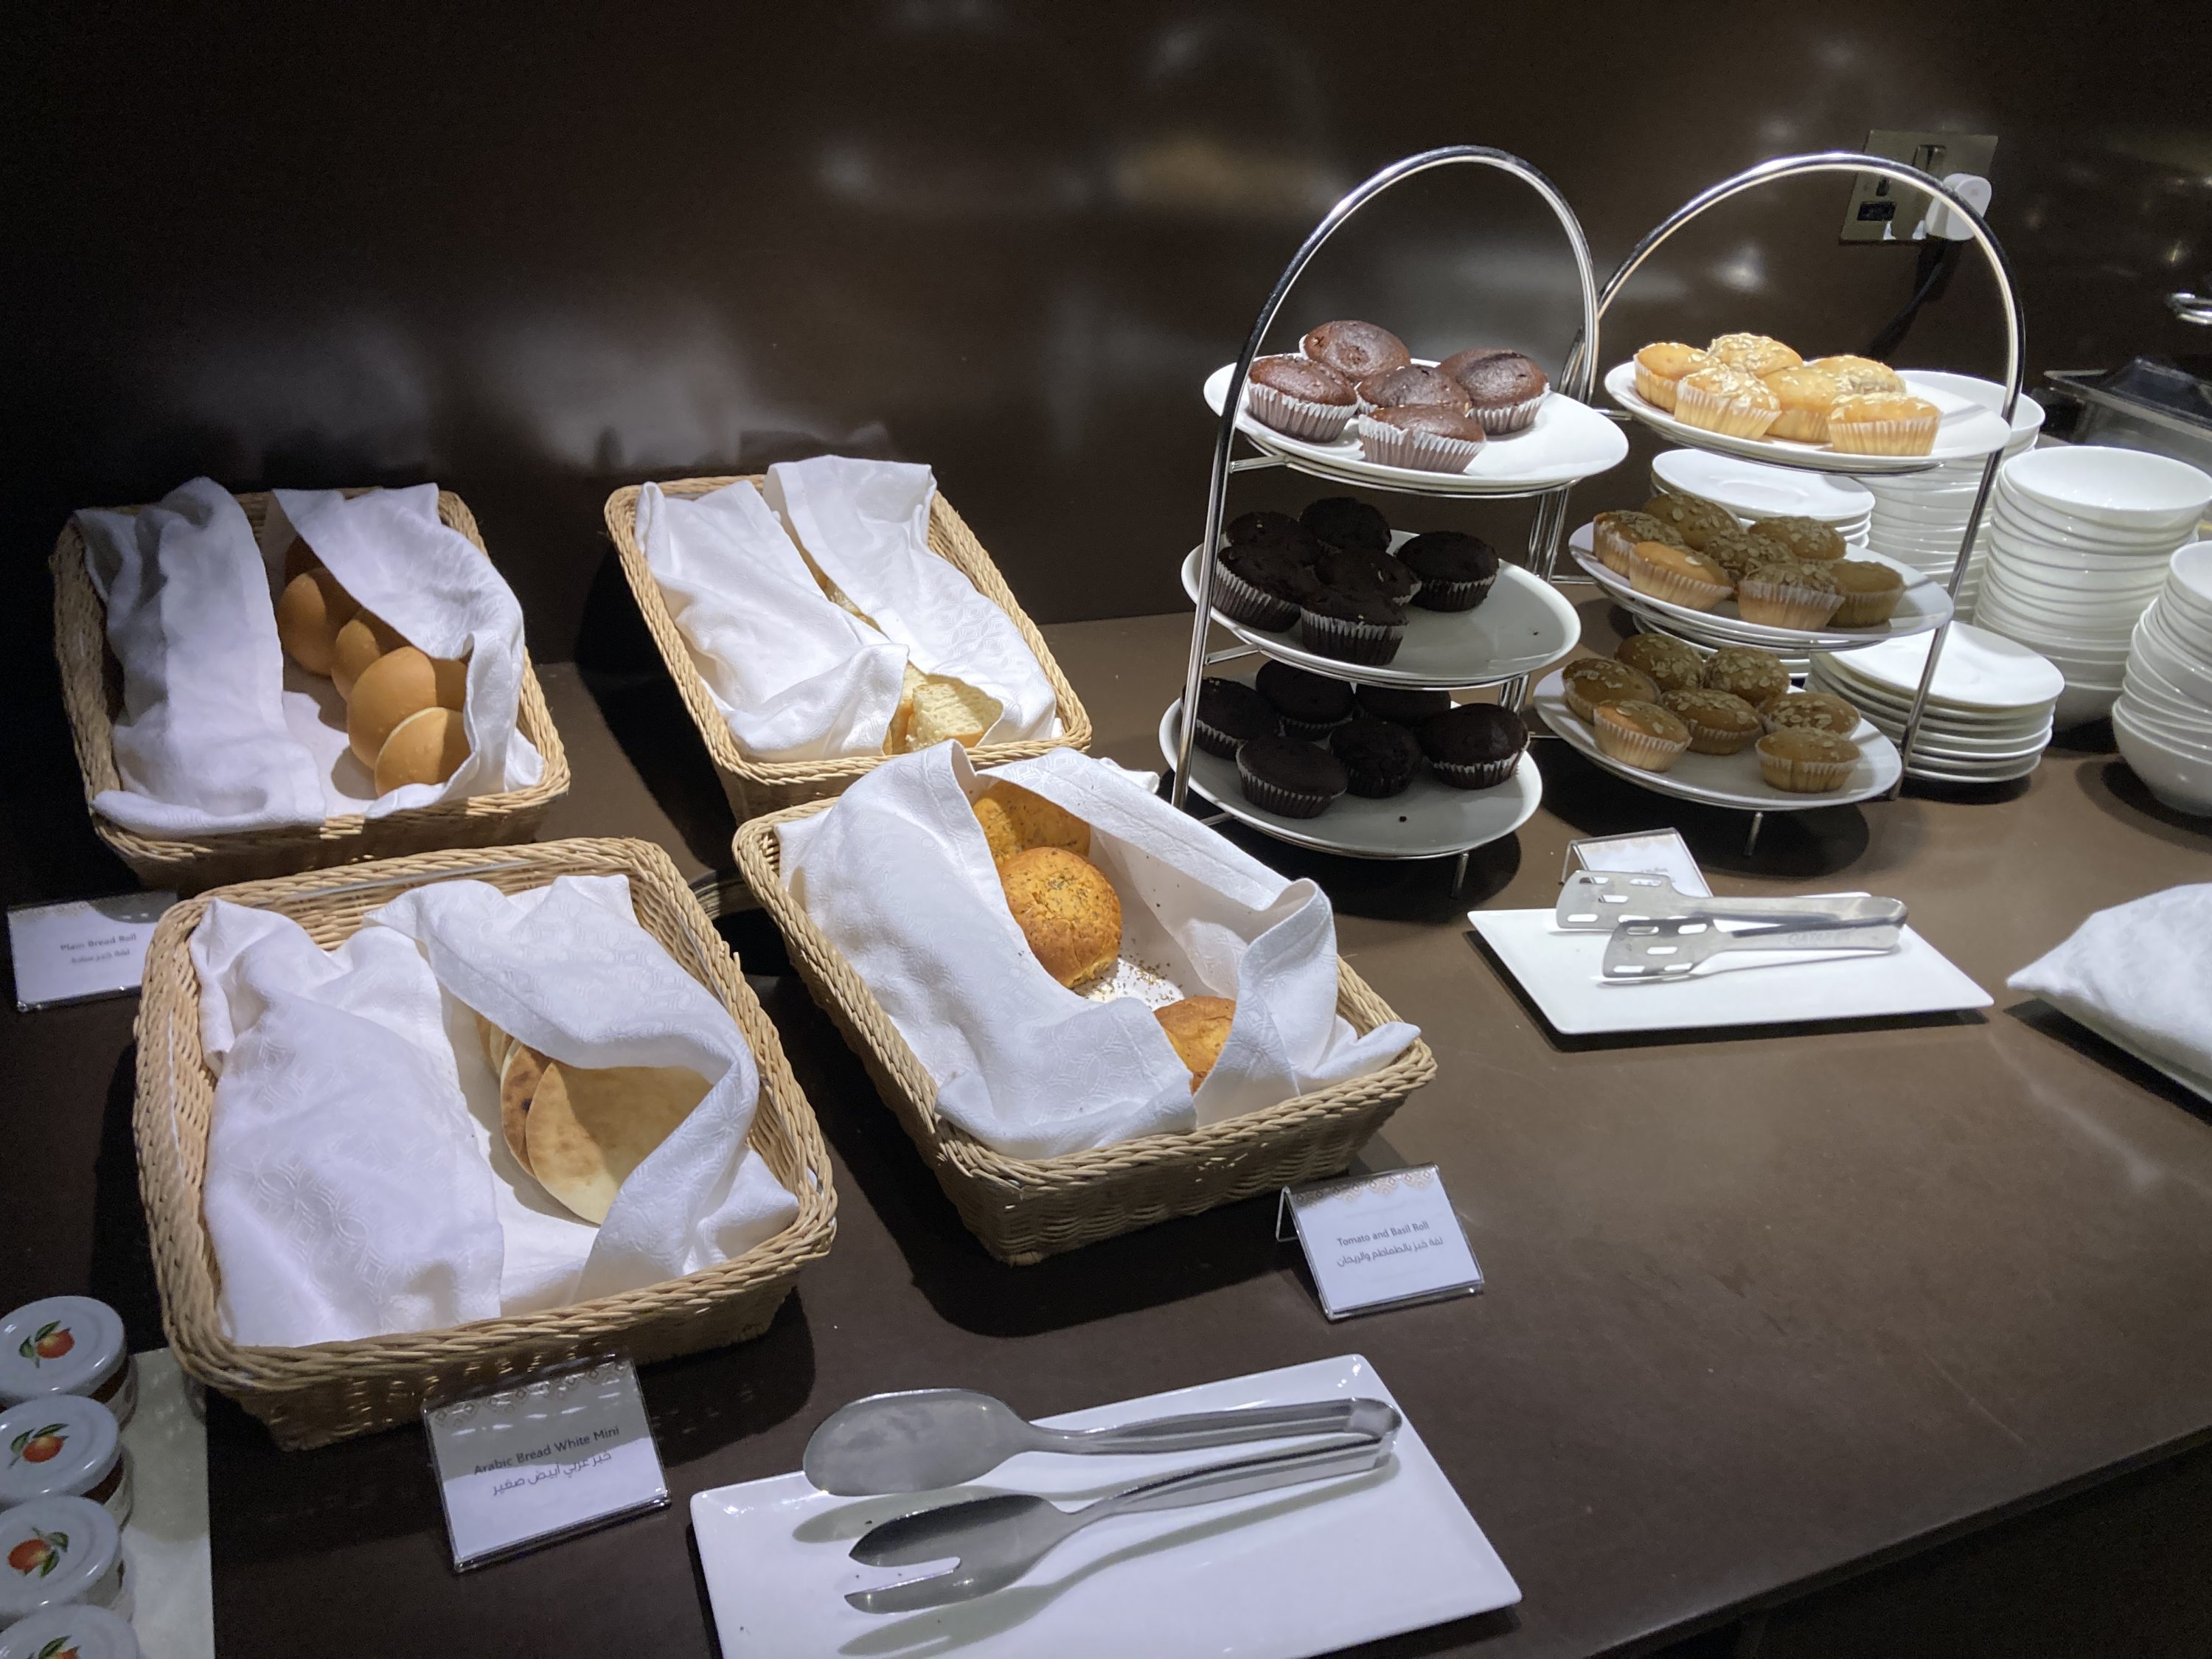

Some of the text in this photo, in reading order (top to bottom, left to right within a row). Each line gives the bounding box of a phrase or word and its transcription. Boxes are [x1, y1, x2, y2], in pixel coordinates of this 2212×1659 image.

[88, 936, 116, 947] Bread
[119, 932, 136, 942] Roll
[1337, 1220, 1430, 1248] Tomato and Basil Roll
[473, 1425, 620, 1475] Arabic Bread White Mini
[591, 1450, 612, 1467] خبز
[563, 1458, 590, 1479] عربي
[492, 1475, 525, 1495] صغير
